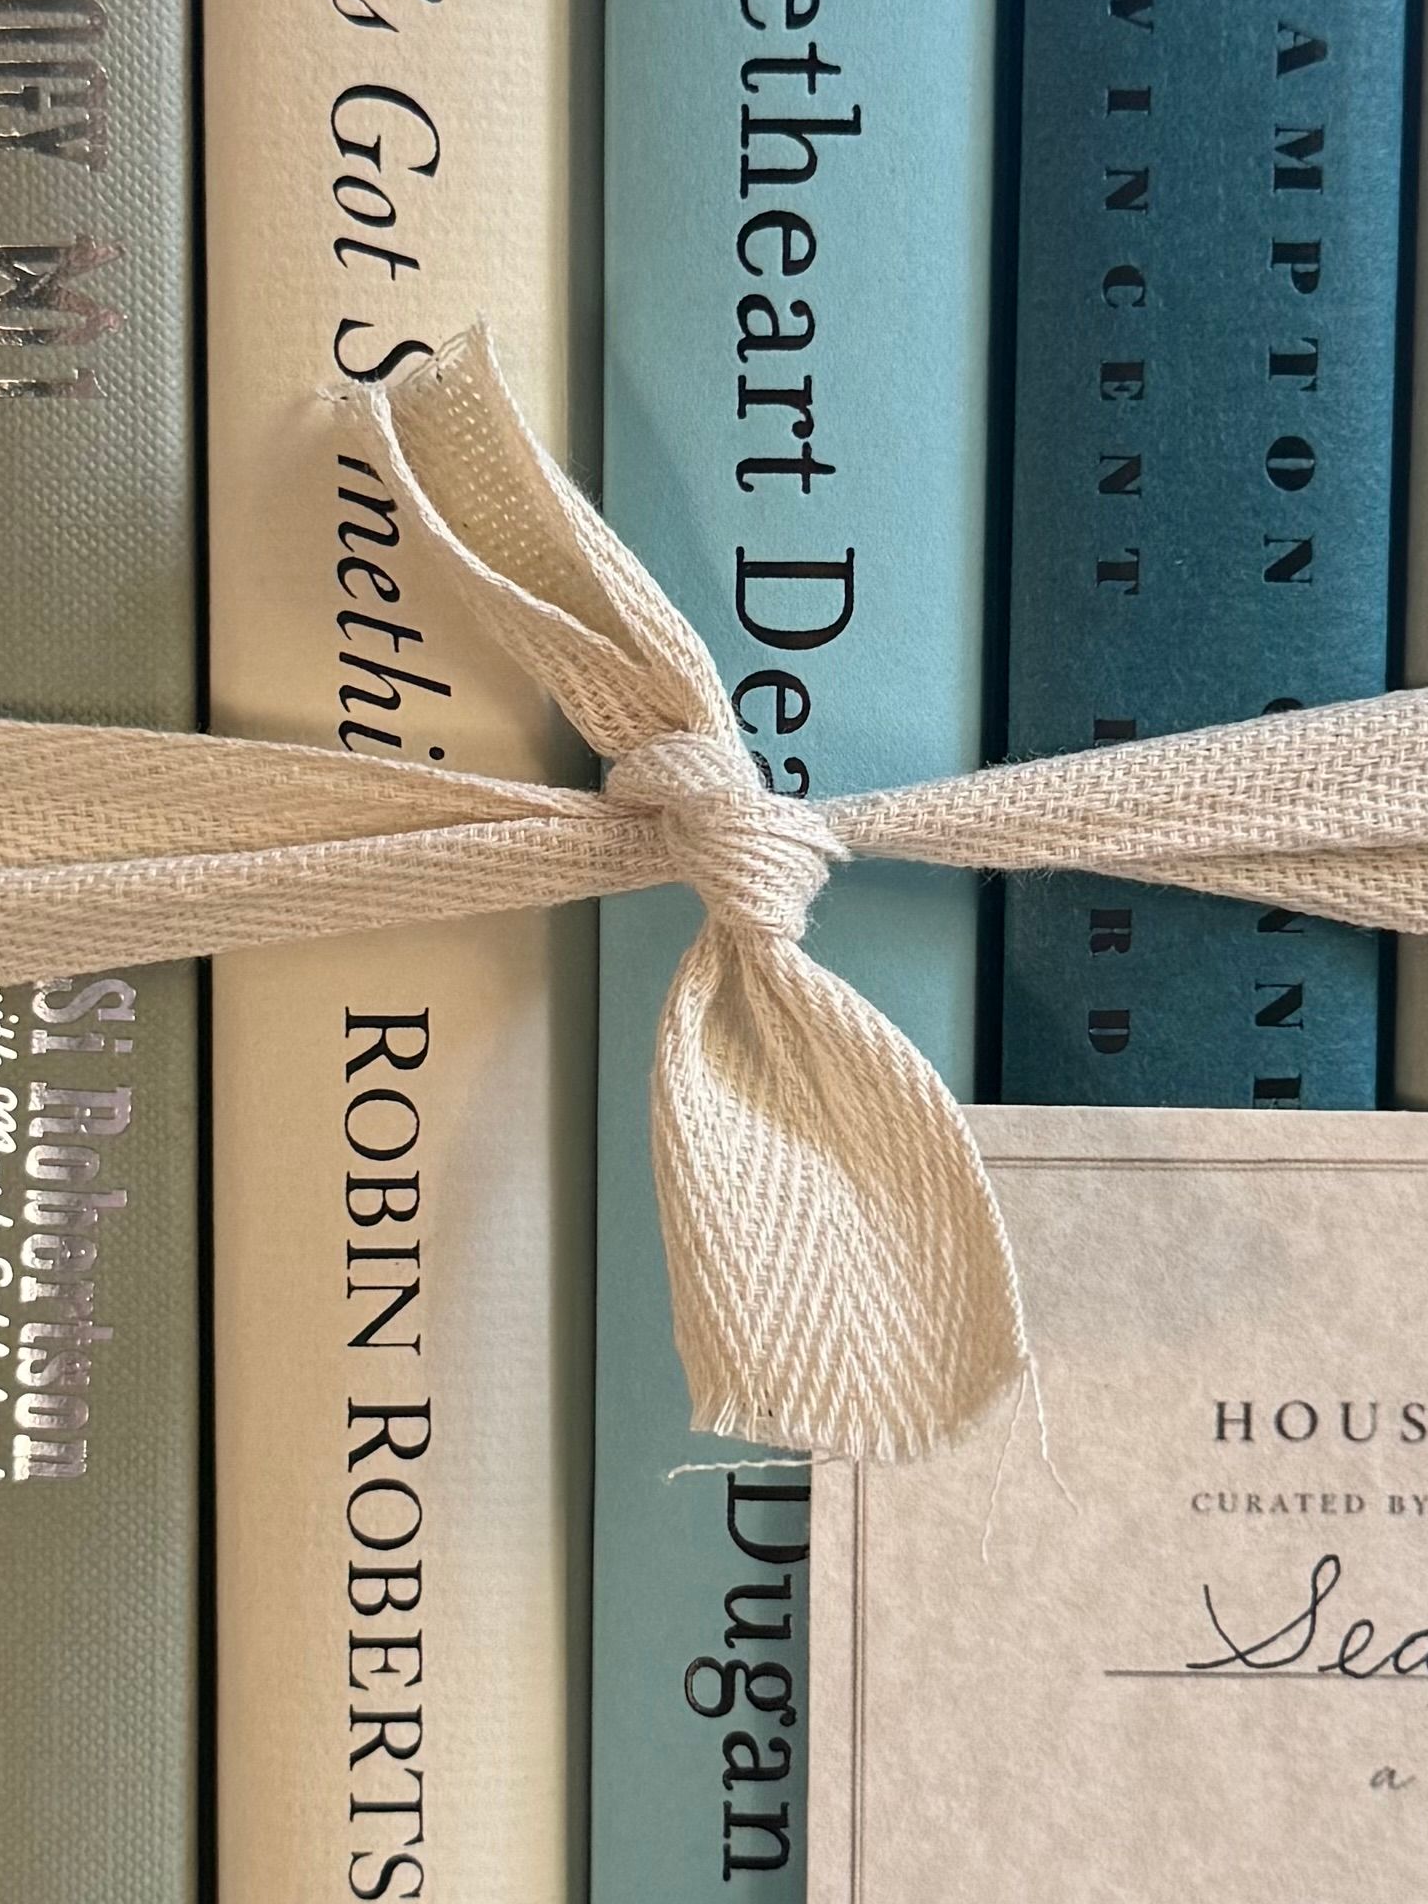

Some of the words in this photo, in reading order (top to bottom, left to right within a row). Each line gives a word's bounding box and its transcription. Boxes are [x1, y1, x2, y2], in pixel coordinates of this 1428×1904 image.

[329, 84, 442, 281] Got
[31, 977, 137, 1056] Si
[11, 1082, 132, 1482] Robertson
[344, 1006, 430, 1355] ROBIN
[1190, 1491, 1366, 1516] CURATED
[1387, 1494, 1428, 1517] BY
[345, 1396, 433, 1903] ROBERTS
[683, 1471, 812, 1883] Dugan
[1369, 1763, 1417, 1792] a
